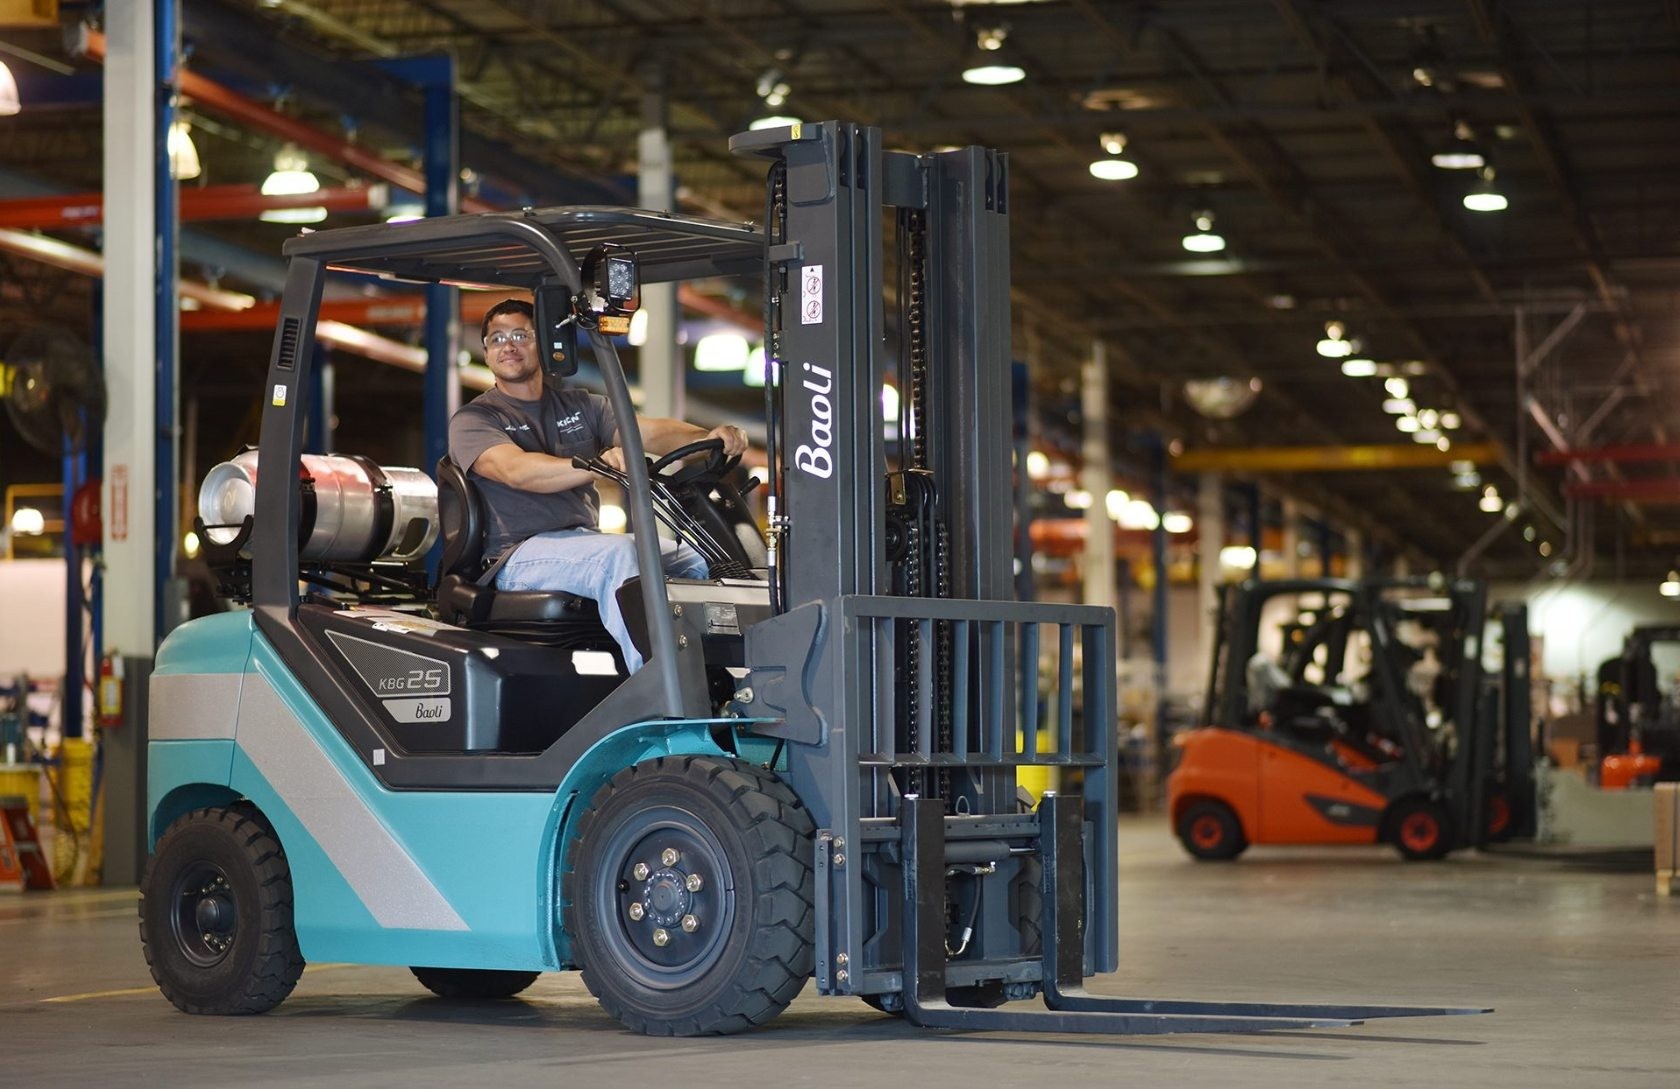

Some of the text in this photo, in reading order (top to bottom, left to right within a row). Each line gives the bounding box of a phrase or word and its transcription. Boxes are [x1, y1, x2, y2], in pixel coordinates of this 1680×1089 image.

[795, 362, 833, 479] Baoli
[379, 669, 442, 690] KBG 25
[415, 702, 443, 719] Baoli
